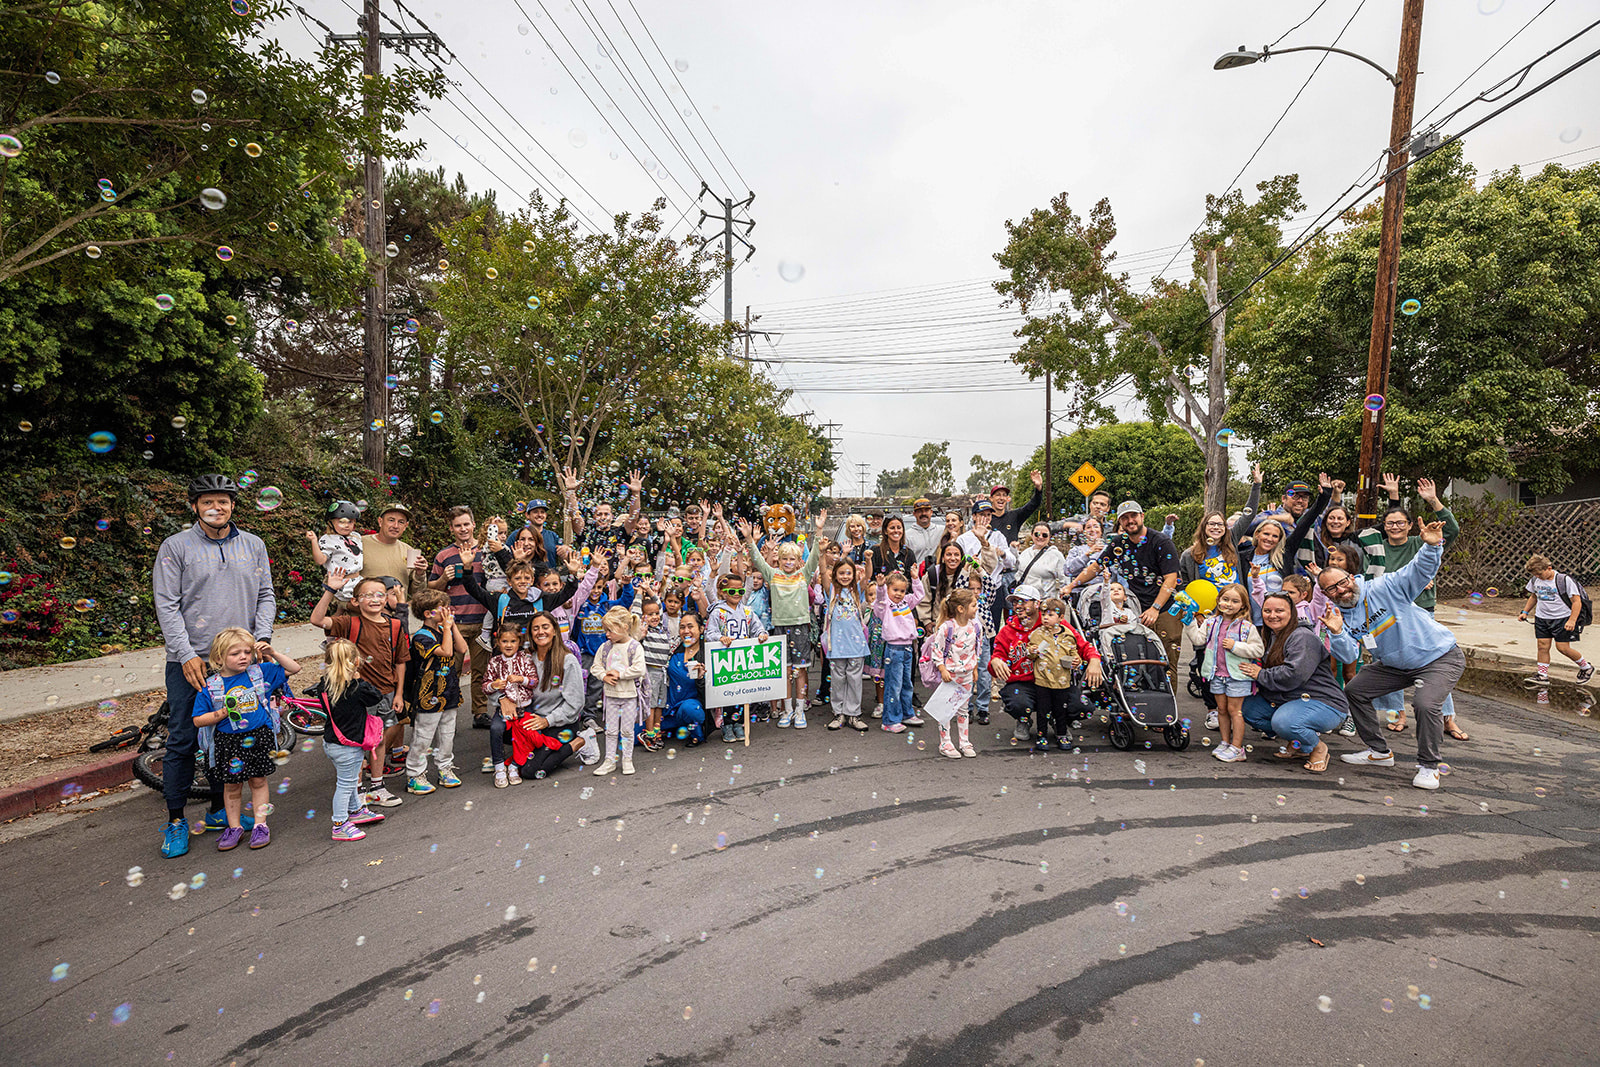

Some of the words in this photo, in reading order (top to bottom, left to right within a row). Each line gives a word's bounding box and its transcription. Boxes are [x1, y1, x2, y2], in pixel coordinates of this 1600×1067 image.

[1078, 475, 1096, 484] END
[712, 645, 780, 674] WALK
[717, 676, 728, 684] TO
[730, 670, 764, 682] SCHOOL
[766, 668, 780, 676] DAY
